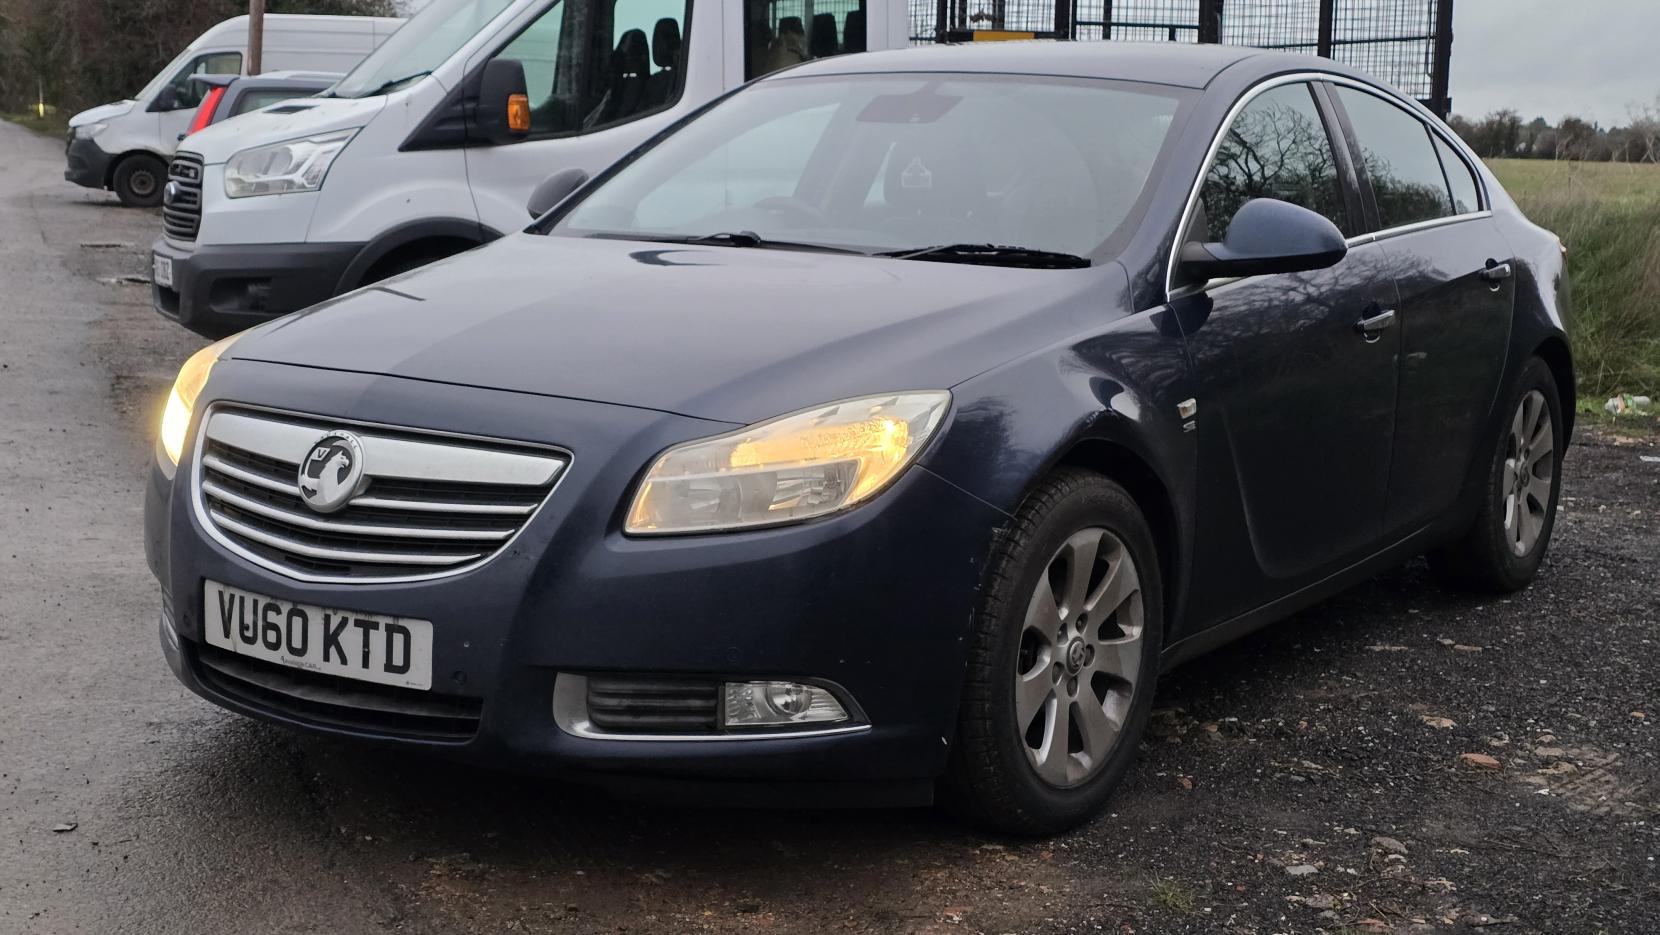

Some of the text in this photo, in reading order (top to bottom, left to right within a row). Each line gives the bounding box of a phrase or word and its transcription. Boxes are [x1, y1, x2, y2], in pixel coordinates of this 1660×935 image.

[317, 449, 327, 458] V
[218, 590, 411, 675] VU60 KTD
